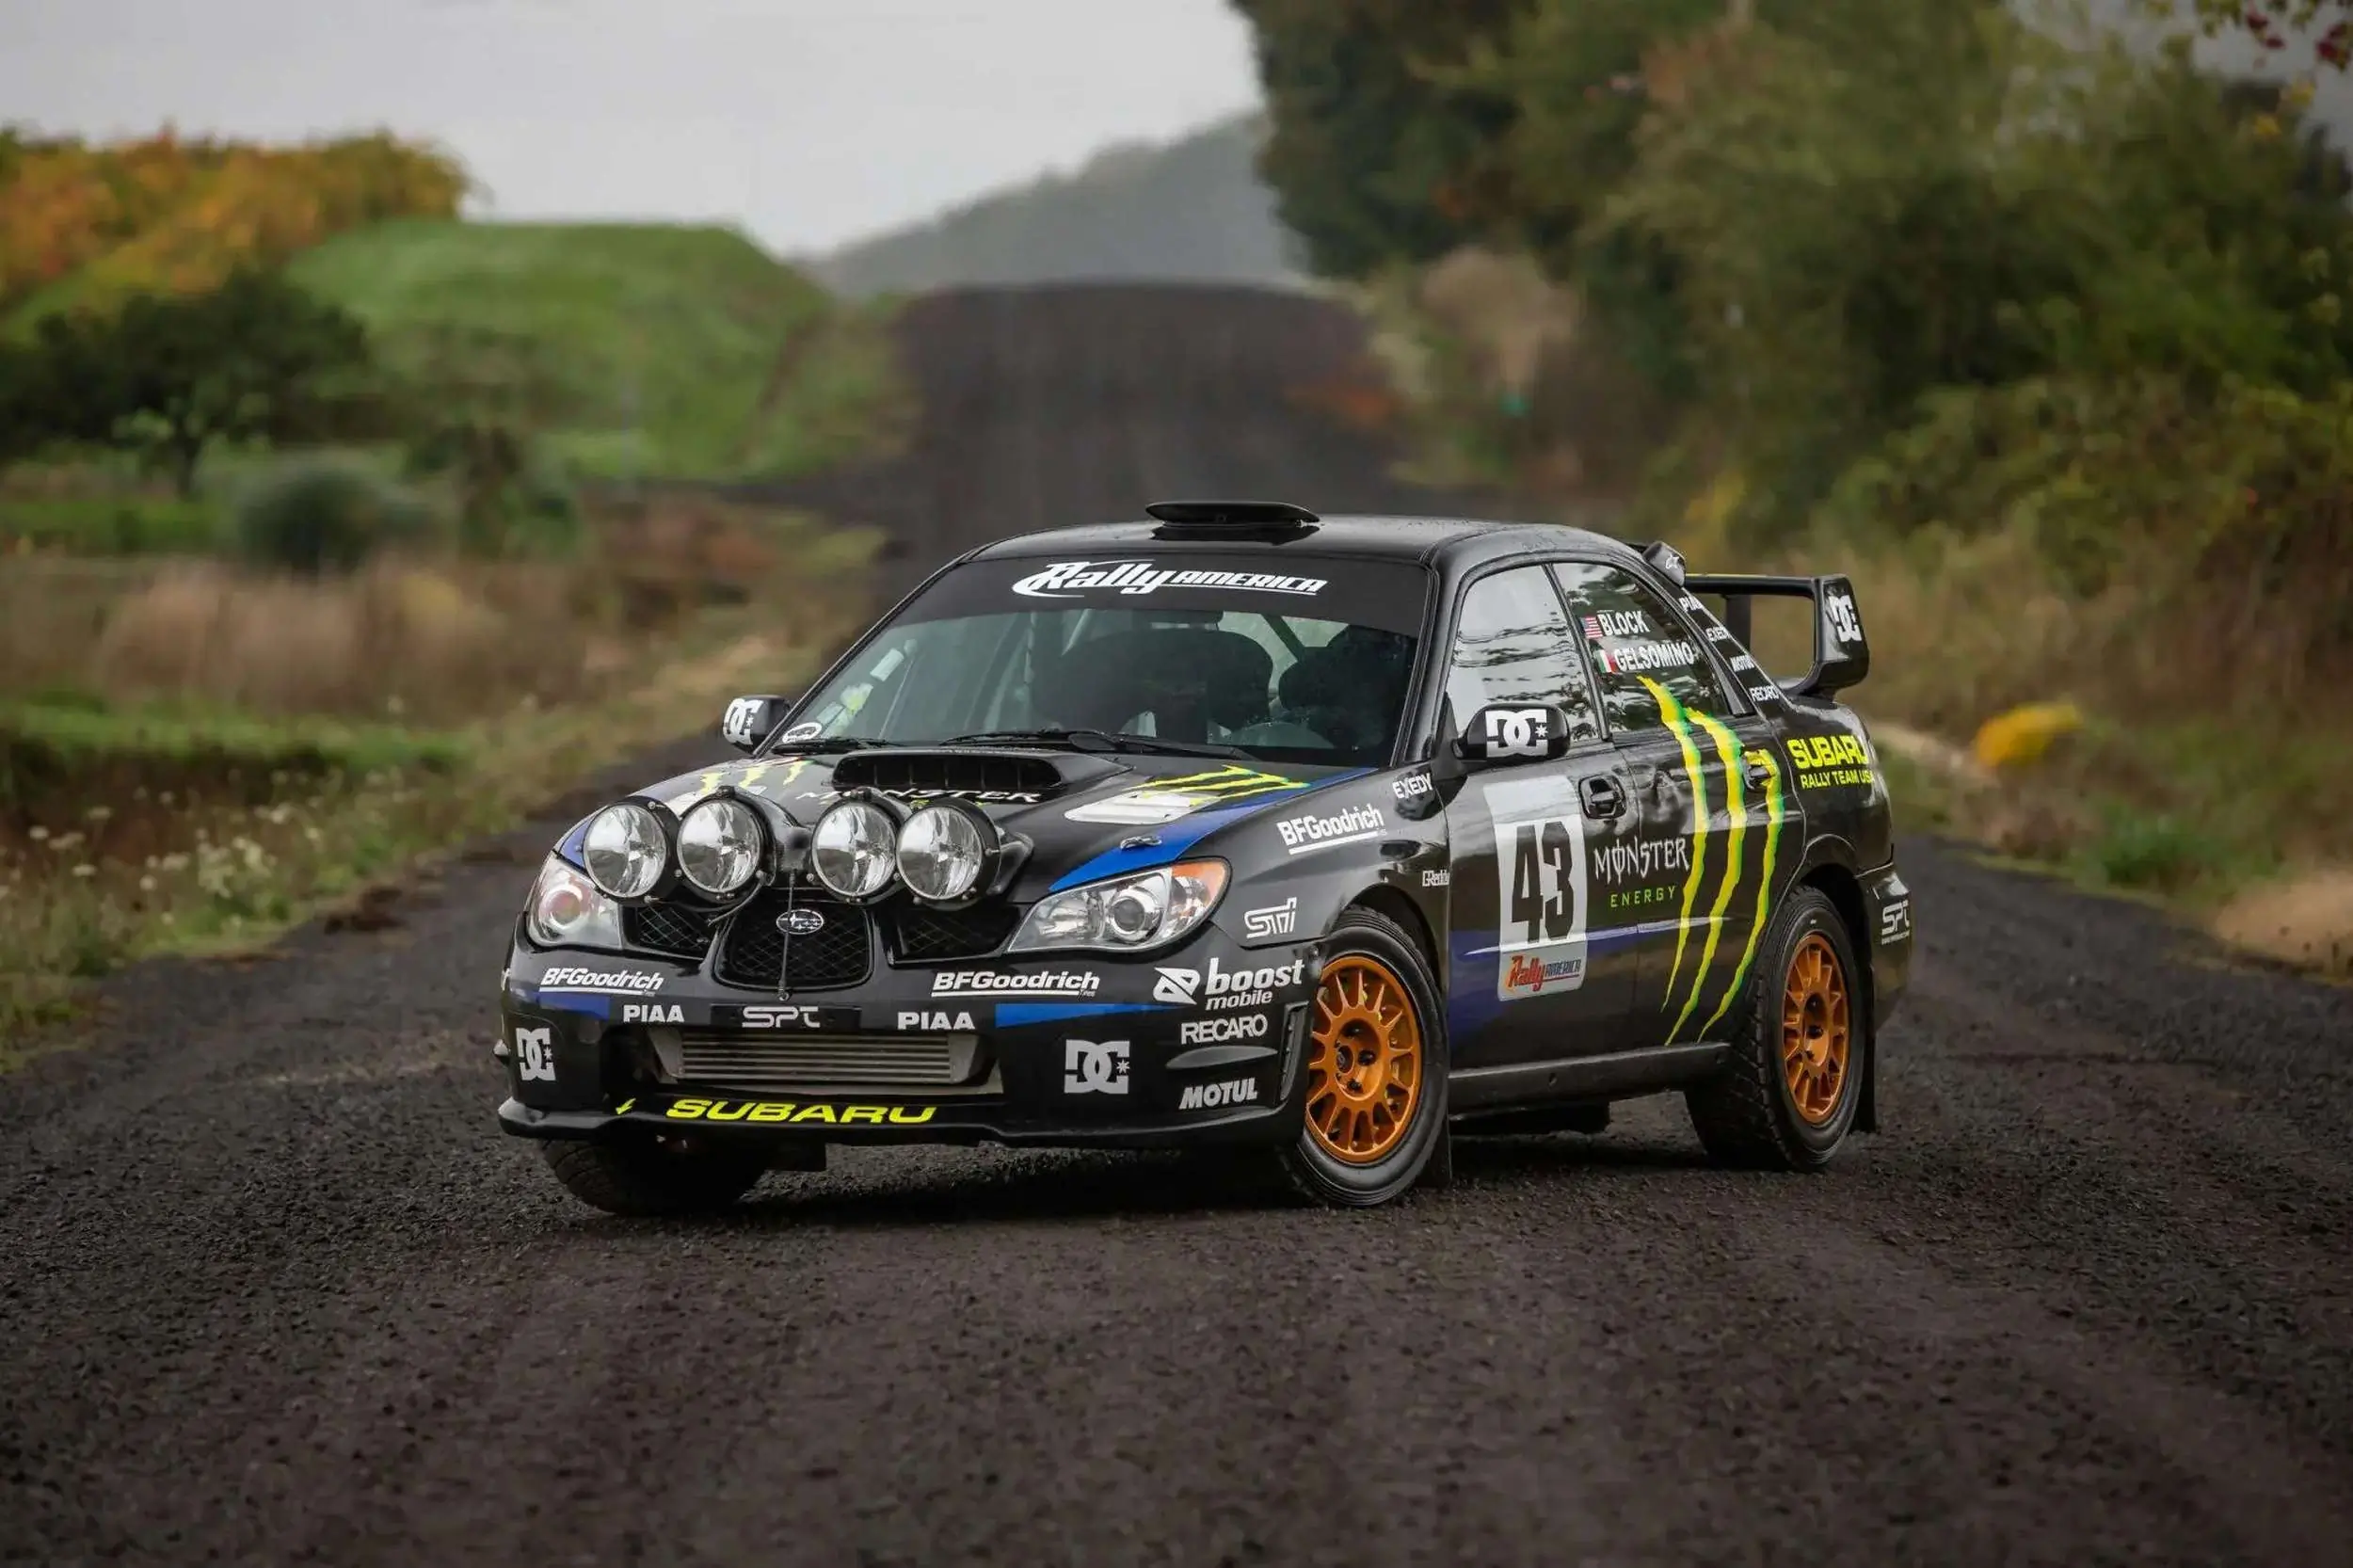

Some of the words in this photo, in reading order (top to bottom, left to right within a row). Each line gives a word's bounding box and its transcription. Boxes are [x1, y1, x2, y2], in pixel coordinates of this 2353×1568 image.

[1013, 559, 1173, 597] Rally
[1170, 570, 1328, 595] AMERICA
[1597, 610, 1651, 636] BLOCK
[1613, 642, 1695, 672] GELSOMINO
[1485, 710, 1548, 757] DC
[1392, 773, 1433, 799] EXEDY
[1800, 772, 1832, 789] RALLY
[1832, 768, 1860, 785] TEAM
[1276, 803, 1385, 846] BFGoodrich
[1593, 835, 1689, 885] MONSTER
[1511, 822, 1575, 944] 43
[1610, 886, 1675, 908] ENERGY
[540, 968, 664, 990] BFGoodrich
[932, 971, 1100, 991] BFGoodrich
[1205, 957, 1305, 996] boost
[1506, 955, 1545, 992] Rally
[623, 1004, 685, 1023] PIAA
[1206, 990, 1273, 1011] mobile
[897, 1012, 976, 1030] PIAA
[1181, 1014, 1268, 1045] RECARO
[516, 1028, 556, 1080] DC
[1064, 1039, 1129, 1094] DC
[1178, 1078, 1258, 1110] MOTUL
[666, 1098, 936, 1124] SUBARU
